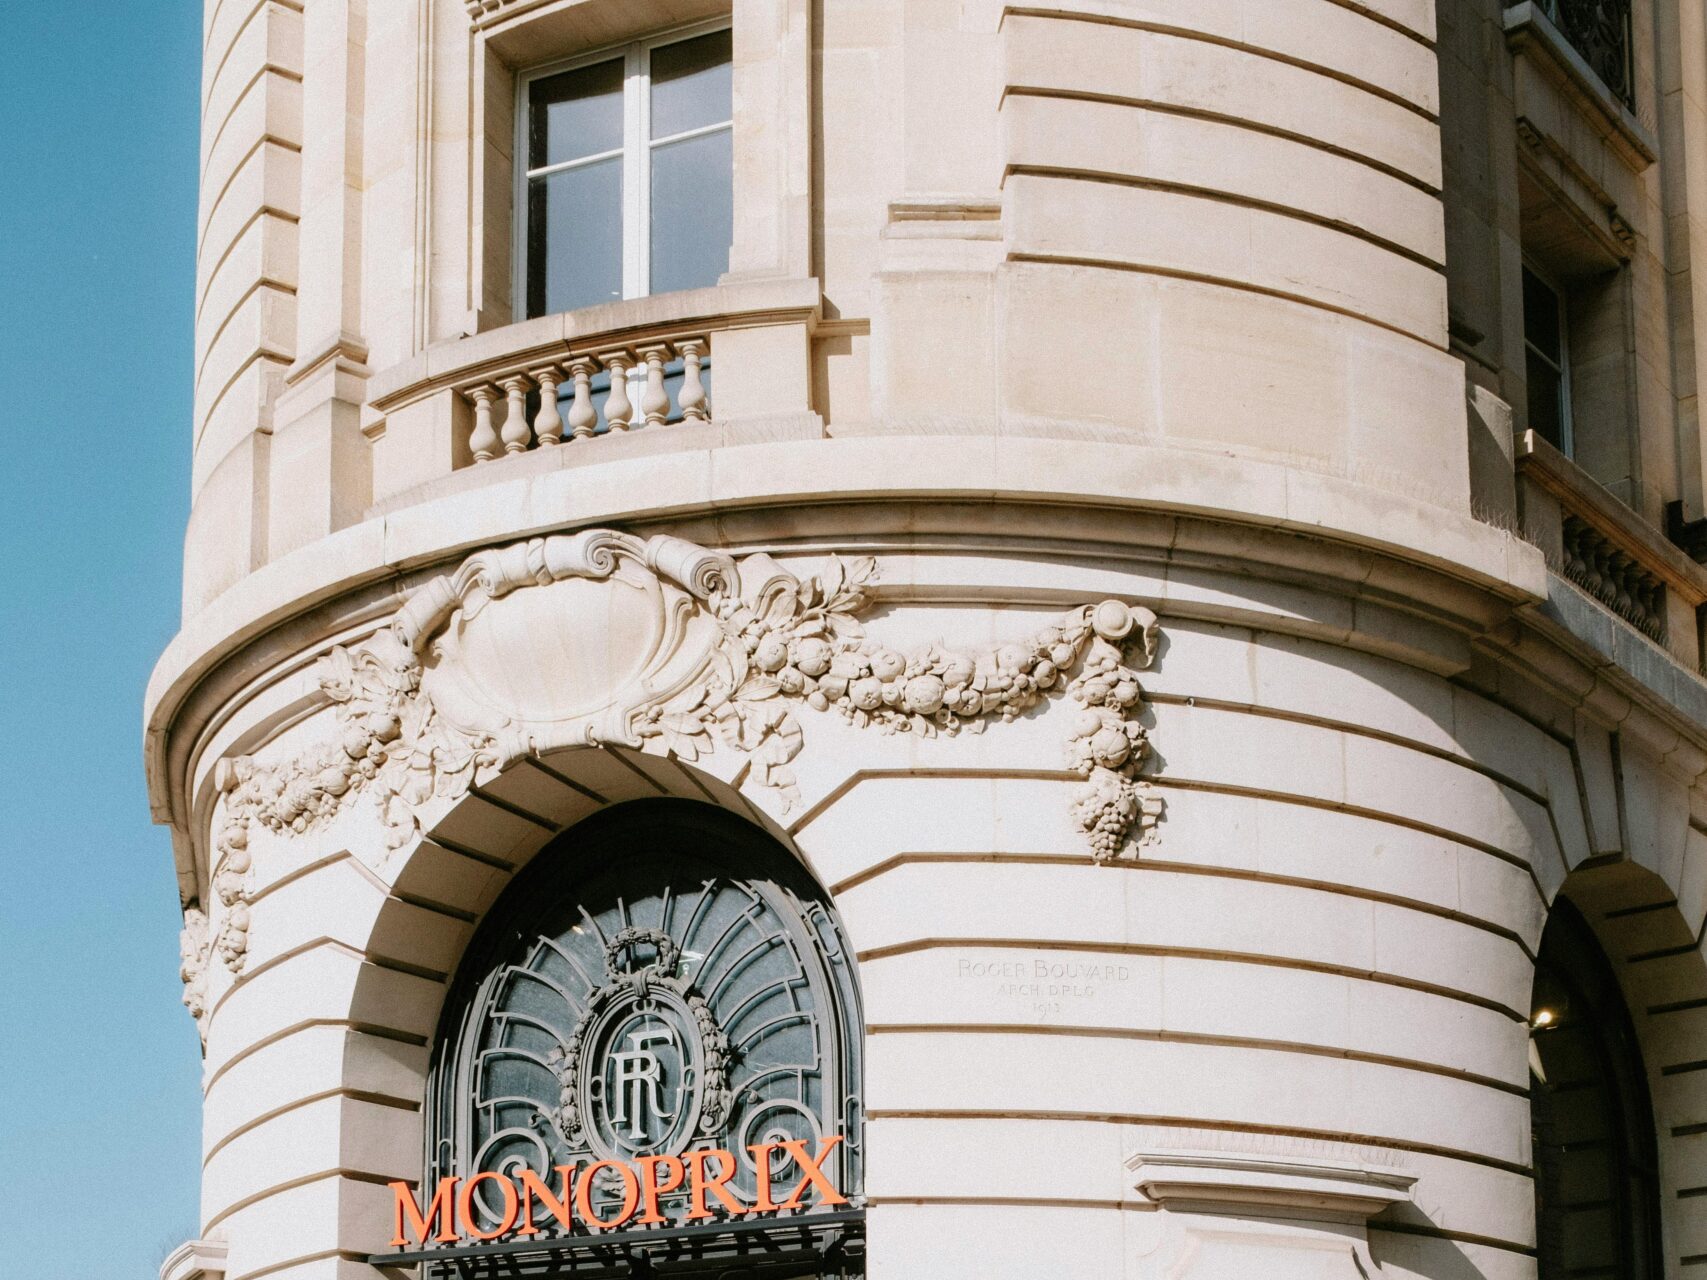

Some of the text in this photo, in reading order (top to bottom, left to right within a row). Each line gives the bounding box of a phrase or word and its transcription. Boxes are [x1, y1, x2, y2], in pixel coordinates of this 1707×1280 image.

[958, 958, 1129, 981] ROGER BOUVARD
[387, 1134, 848, 1247] MONOPRIX
